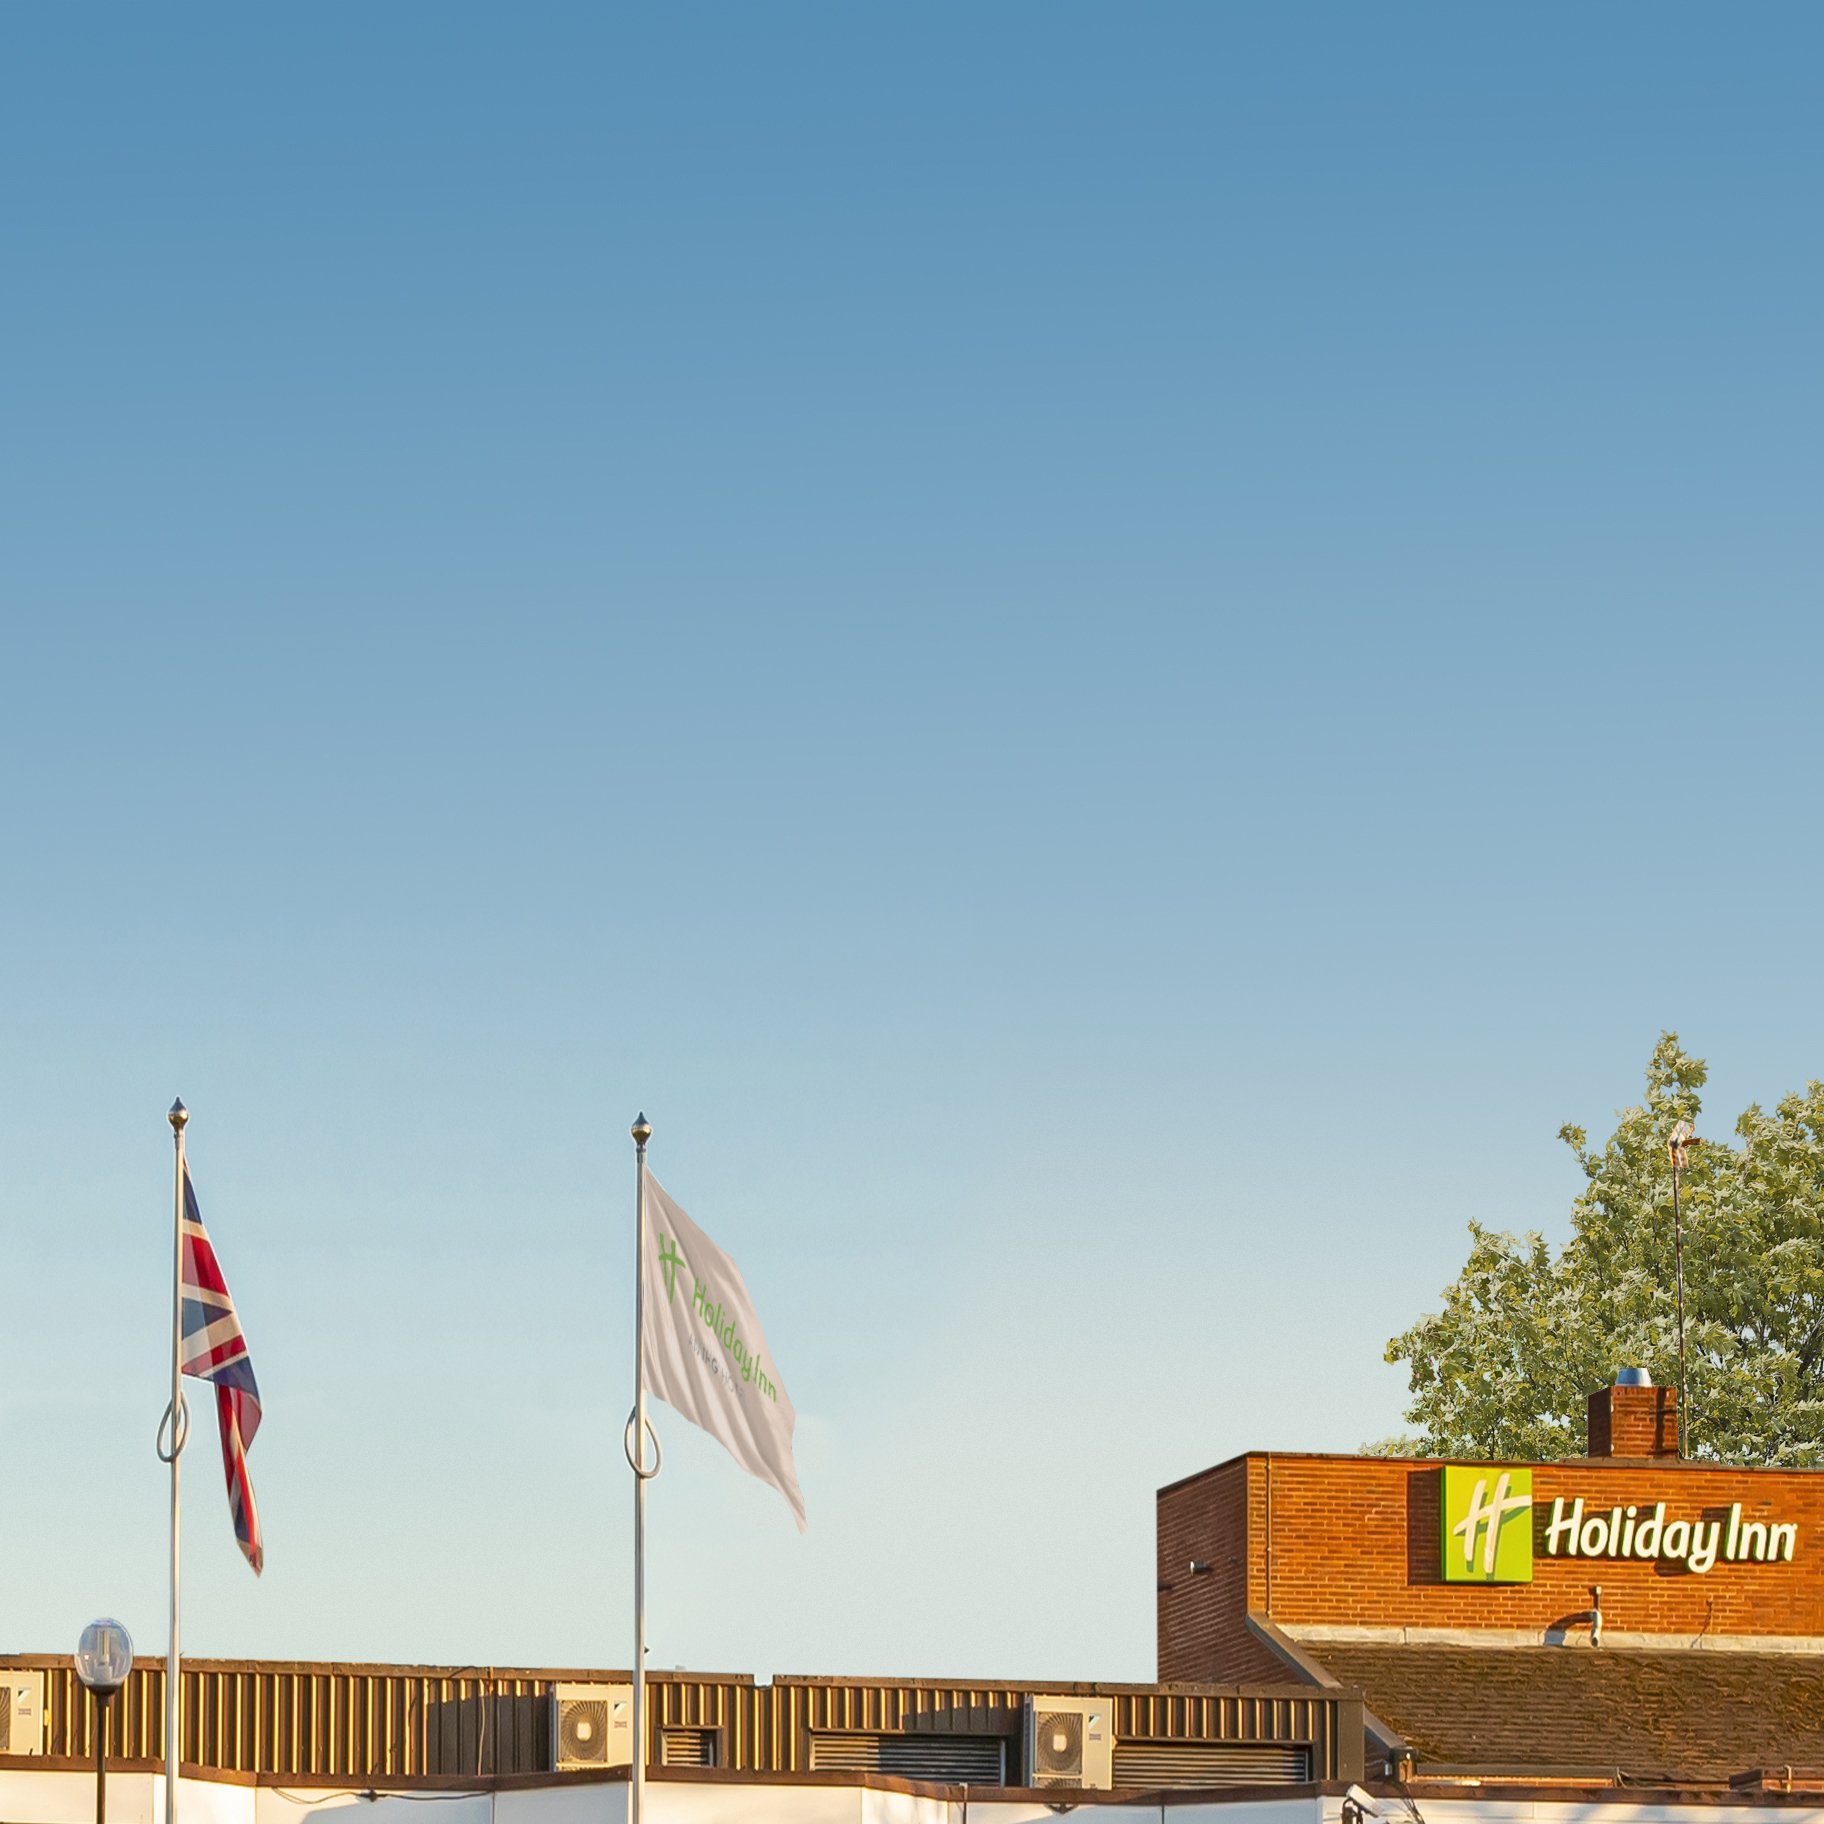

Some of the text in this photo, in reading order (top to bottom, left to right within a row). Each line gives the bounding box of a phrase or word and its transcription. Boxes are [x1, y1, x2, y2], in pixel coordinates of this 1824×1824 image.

[692, 1277, 777, 1402] Holiday Inn
[1545, 1497, 1796, 1574] Holiday Inn
